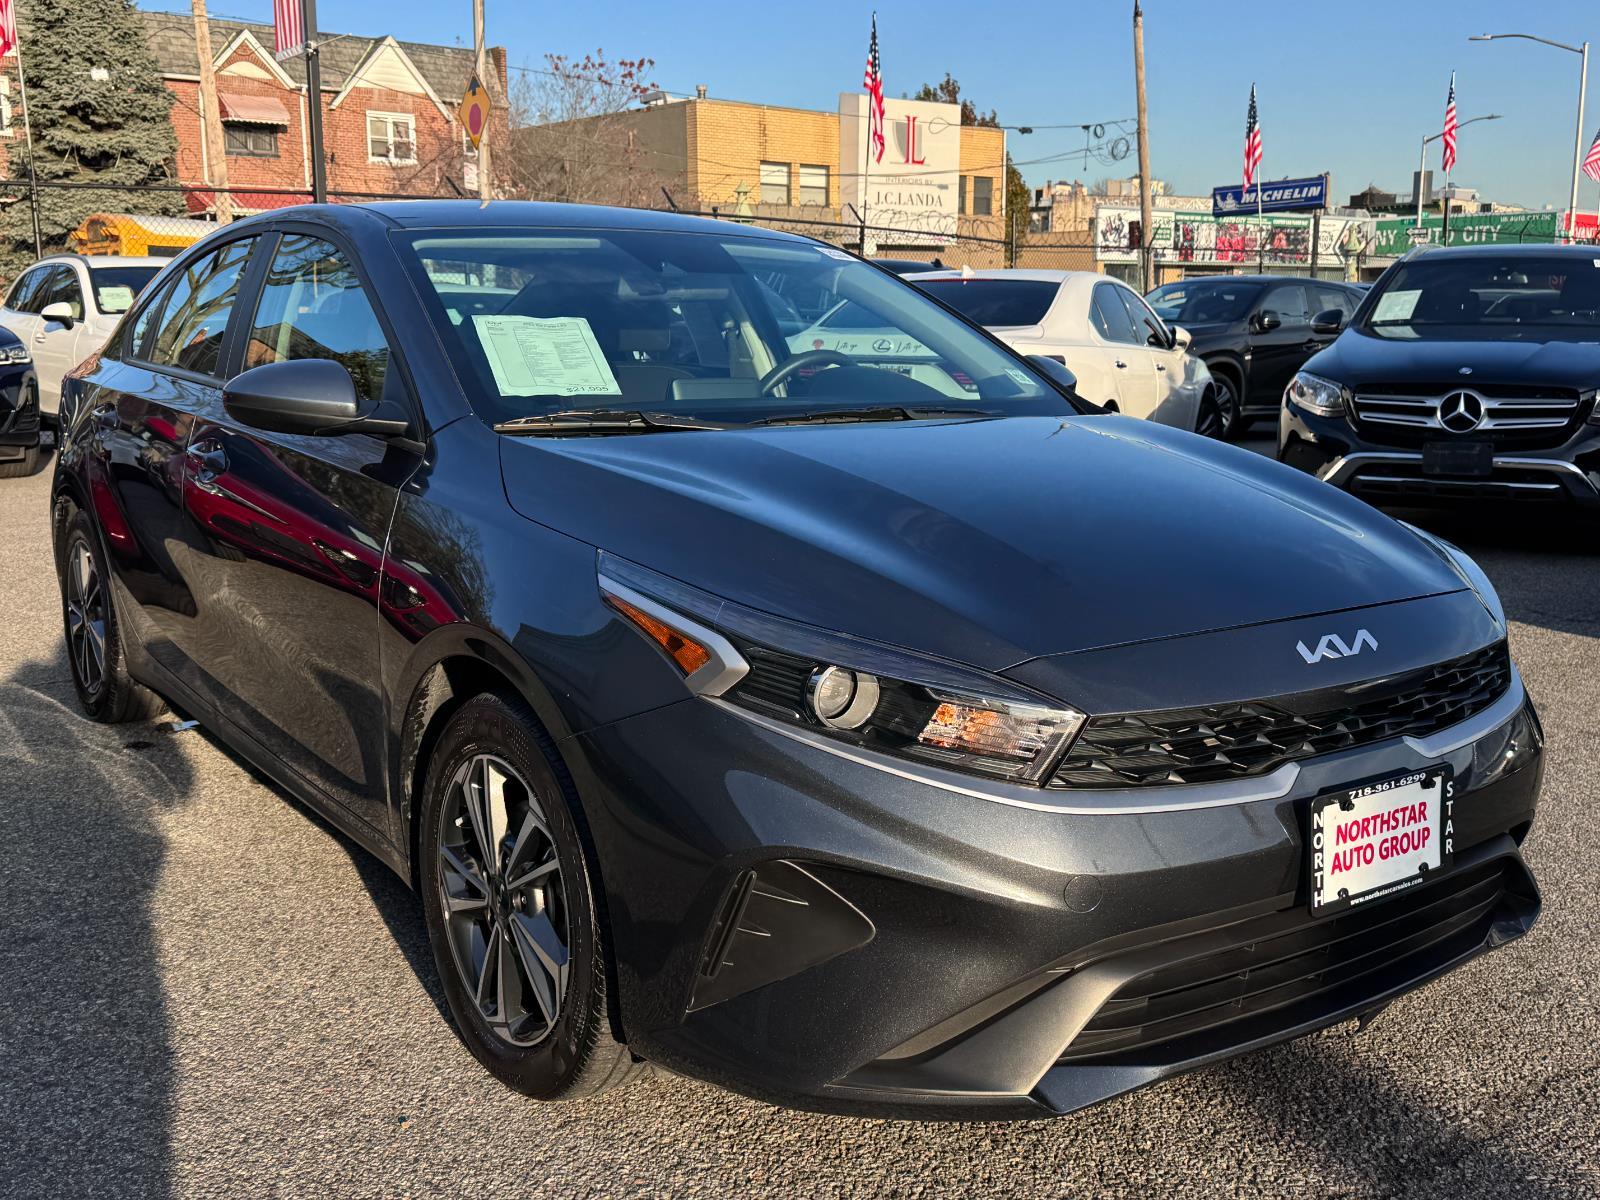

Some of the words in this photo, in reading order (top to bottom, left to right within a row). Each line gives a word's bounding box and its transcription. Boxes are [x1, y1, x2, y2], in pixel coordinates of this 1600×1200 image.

[1241, 185, 1321, 204] MCHELIN
[1376, 229, 1398, 246] NY
[1462, 225, 1501, 242] CITY
[1296, 629, 1379, 664] KIA
[1348, 772, 1426, 800] 718-361-6299
[1335, 801, 1428, 846] NORTHSTAR
[1445, 781, 1454, 854] STAR
[1313, 811, 1325, 908] NORTH
[1330, 843, 1375, 875] AUTO
[1378, 826, 1431, 860] GROUP
